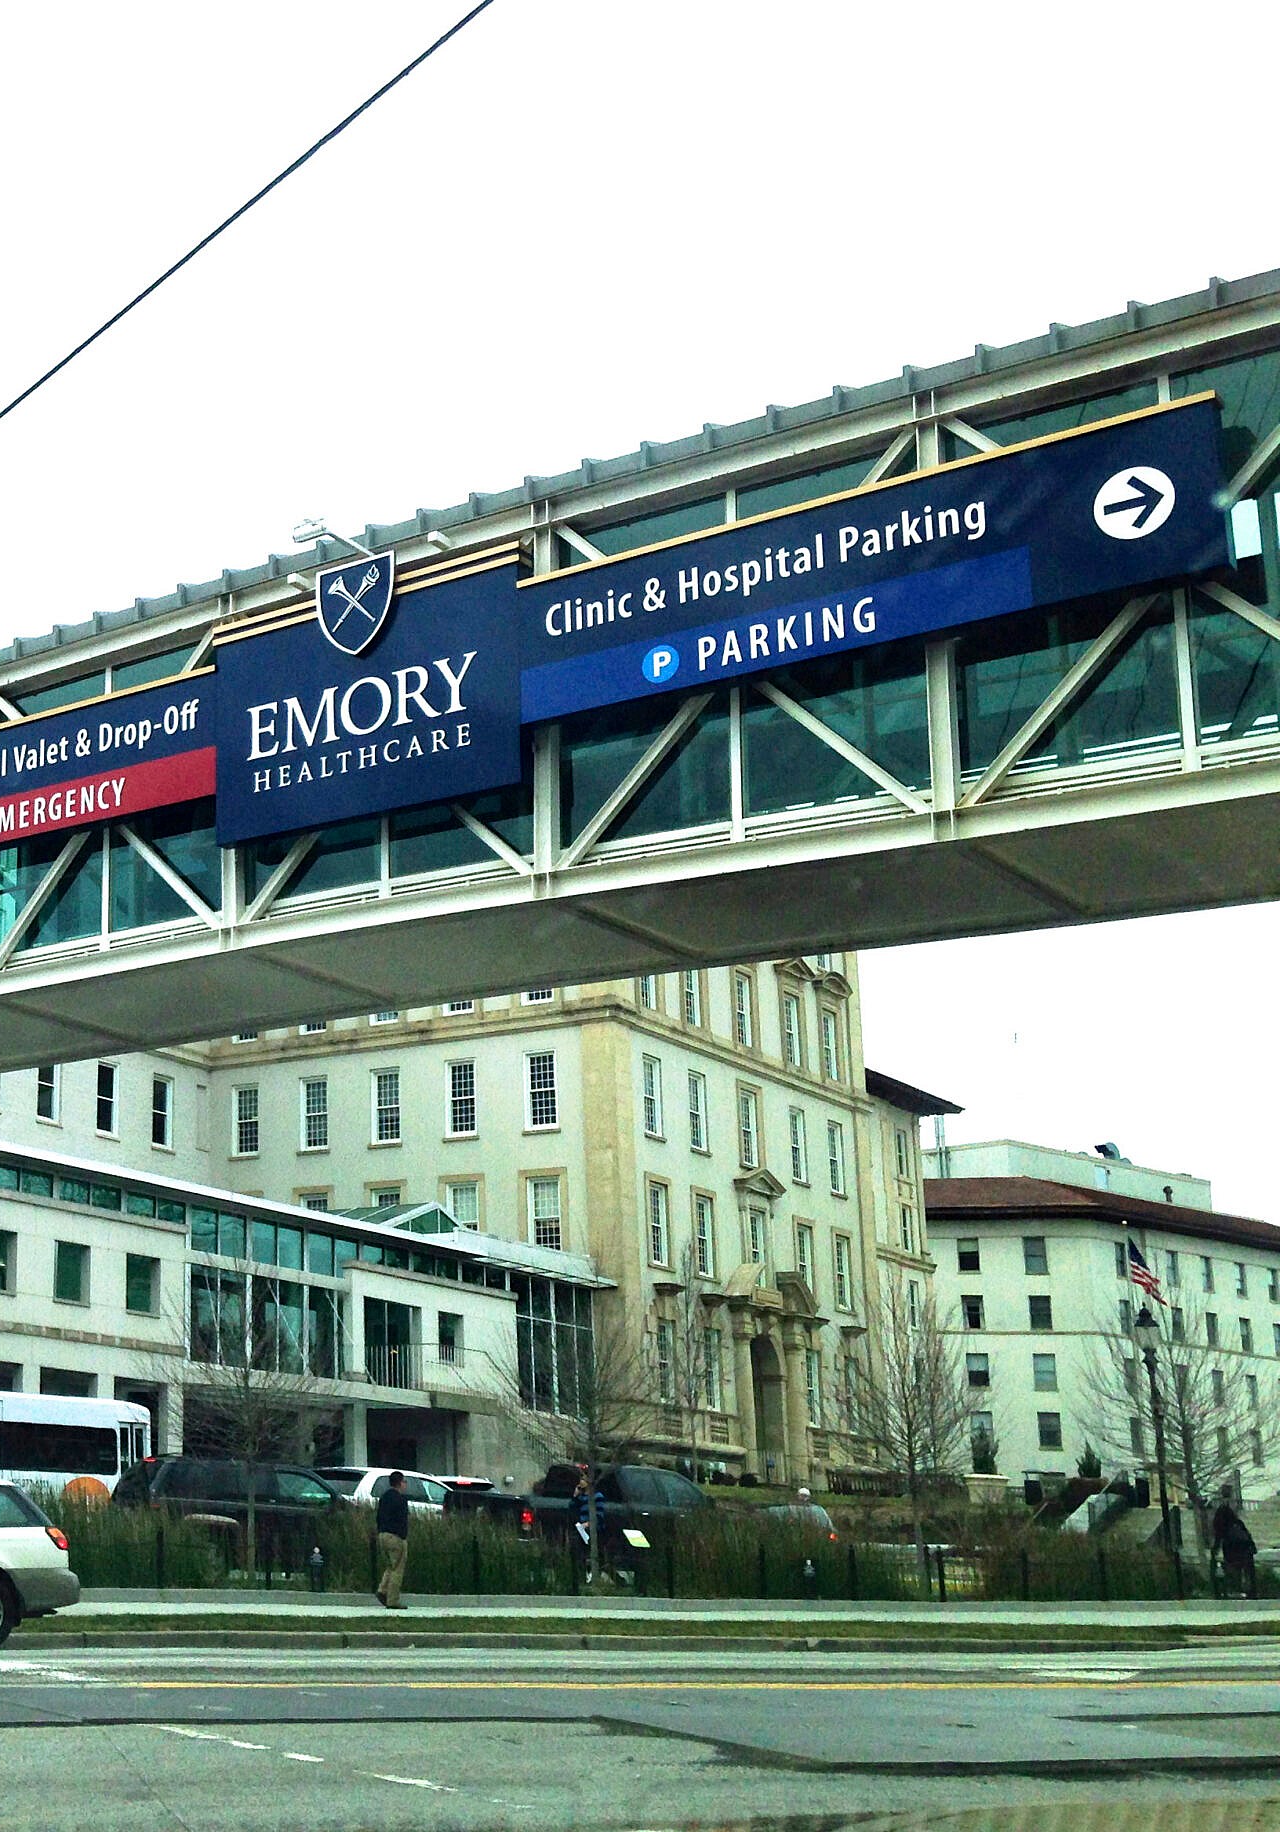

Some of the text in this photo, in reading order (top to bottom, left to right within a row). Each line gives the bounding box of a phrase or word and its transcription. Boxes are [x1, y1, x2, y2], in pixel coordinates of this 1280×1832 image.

[544, 499, 988, 637] Clinic & Hospital Parking
[696, 596, 877, 671] PARKING
[13, 736, 69, 774] Valet
[76, 728, 92, 758] &
[98, 698, 200, 752] Drop-Off
[245, 650, 478, 762] EMORY
[253, 723, 472, 793] HEALTHCARE
